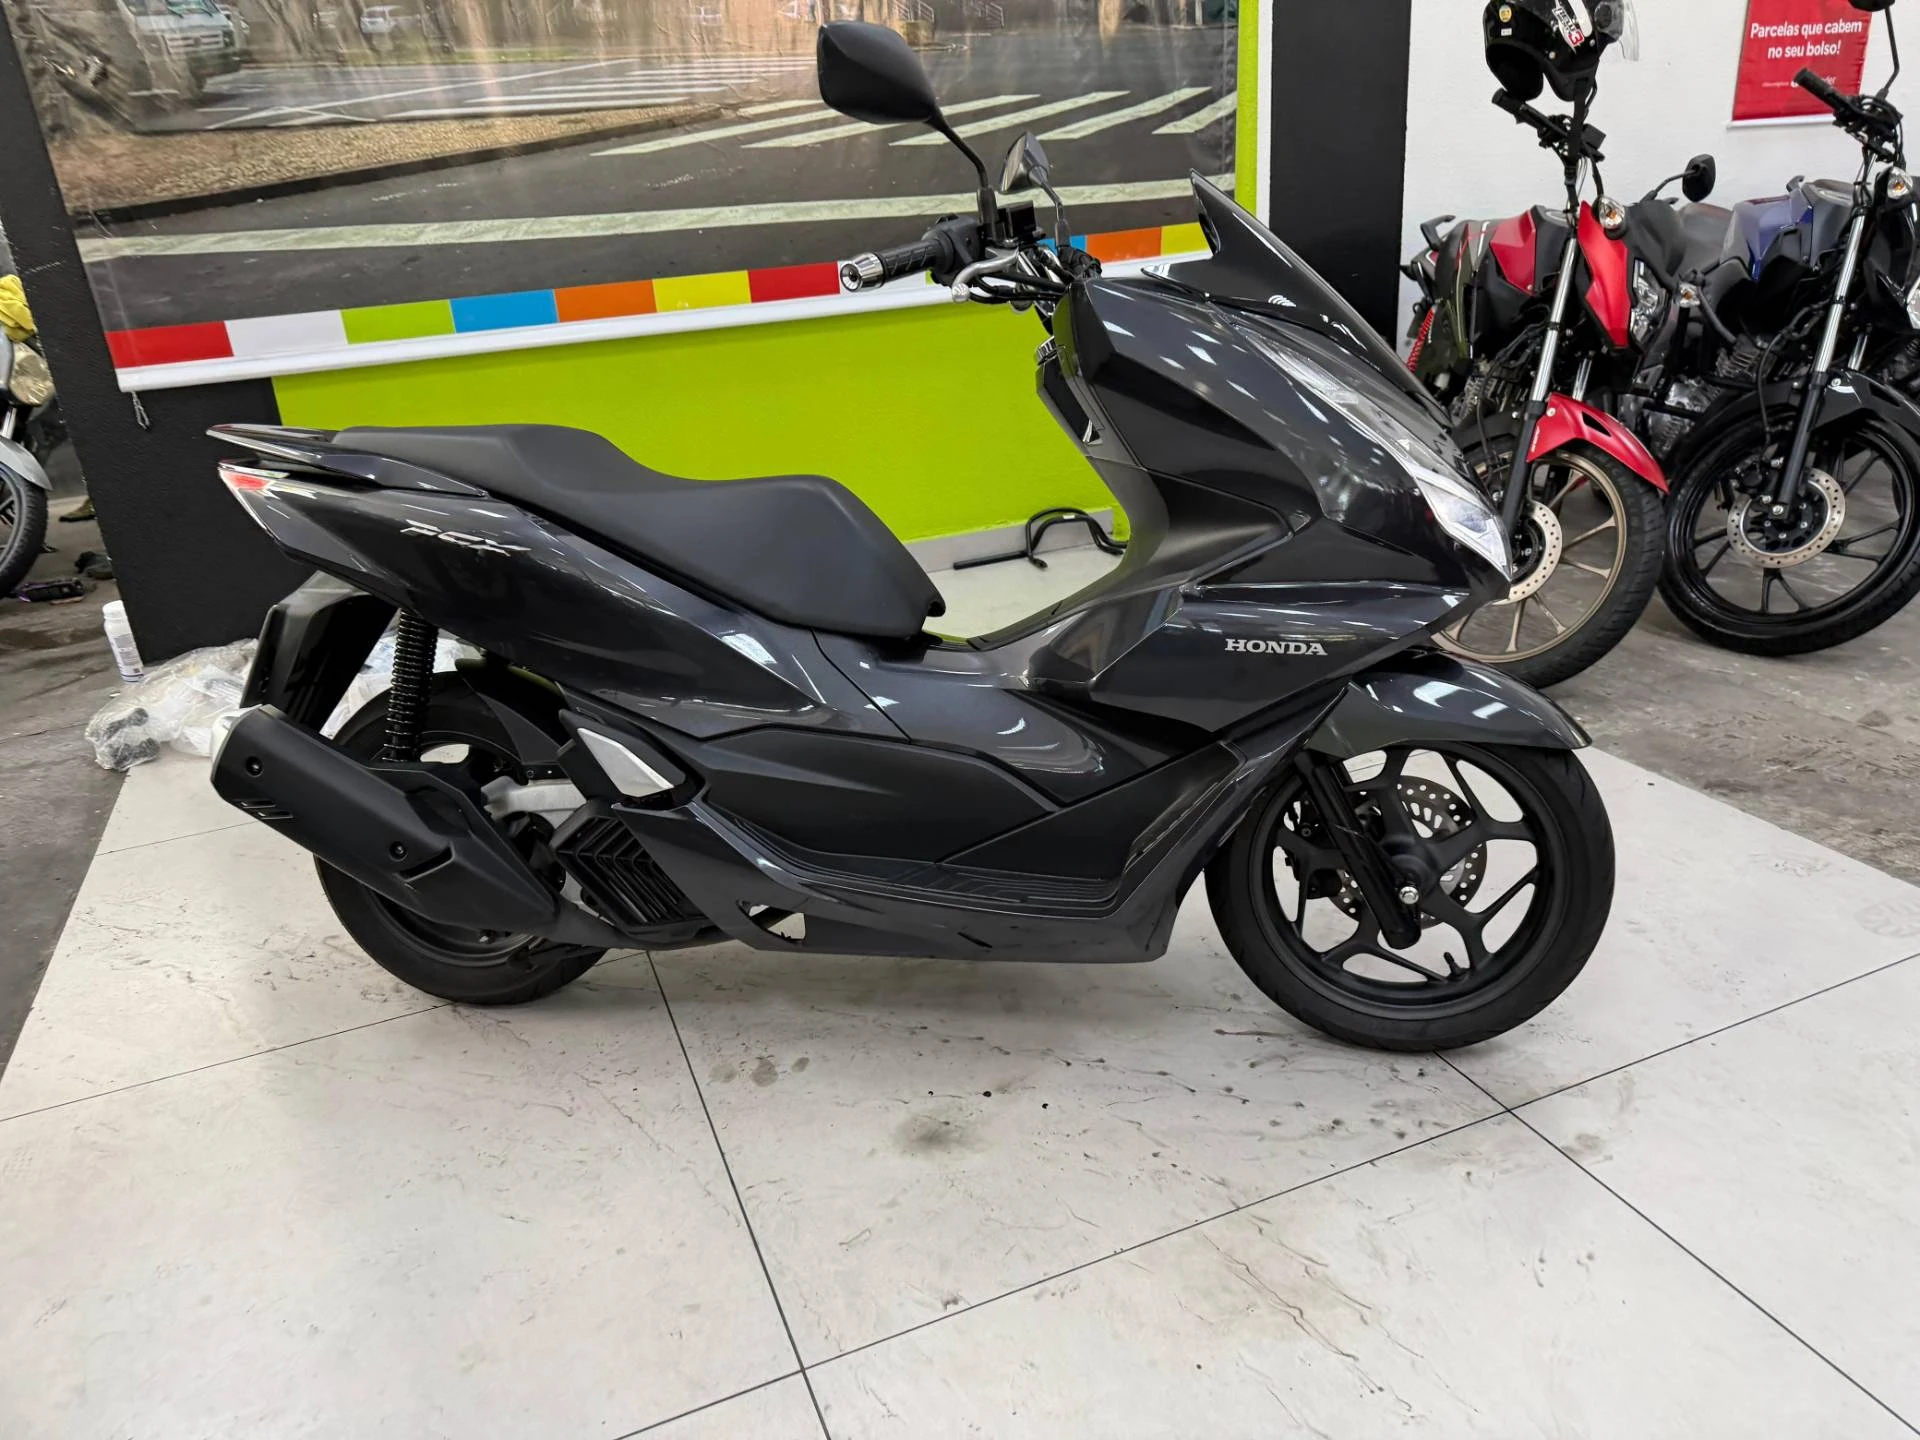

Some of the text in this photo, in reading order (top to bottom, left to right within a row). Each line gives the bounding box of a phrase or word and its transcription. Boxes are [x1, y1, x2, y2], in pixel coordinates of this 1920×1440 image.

[1750, 18, 1863, 39] Parcelas que cabem
[1767, 39, 1841, 59] no seu bolso!
[1224, 638, 1328, 656] HONDA
